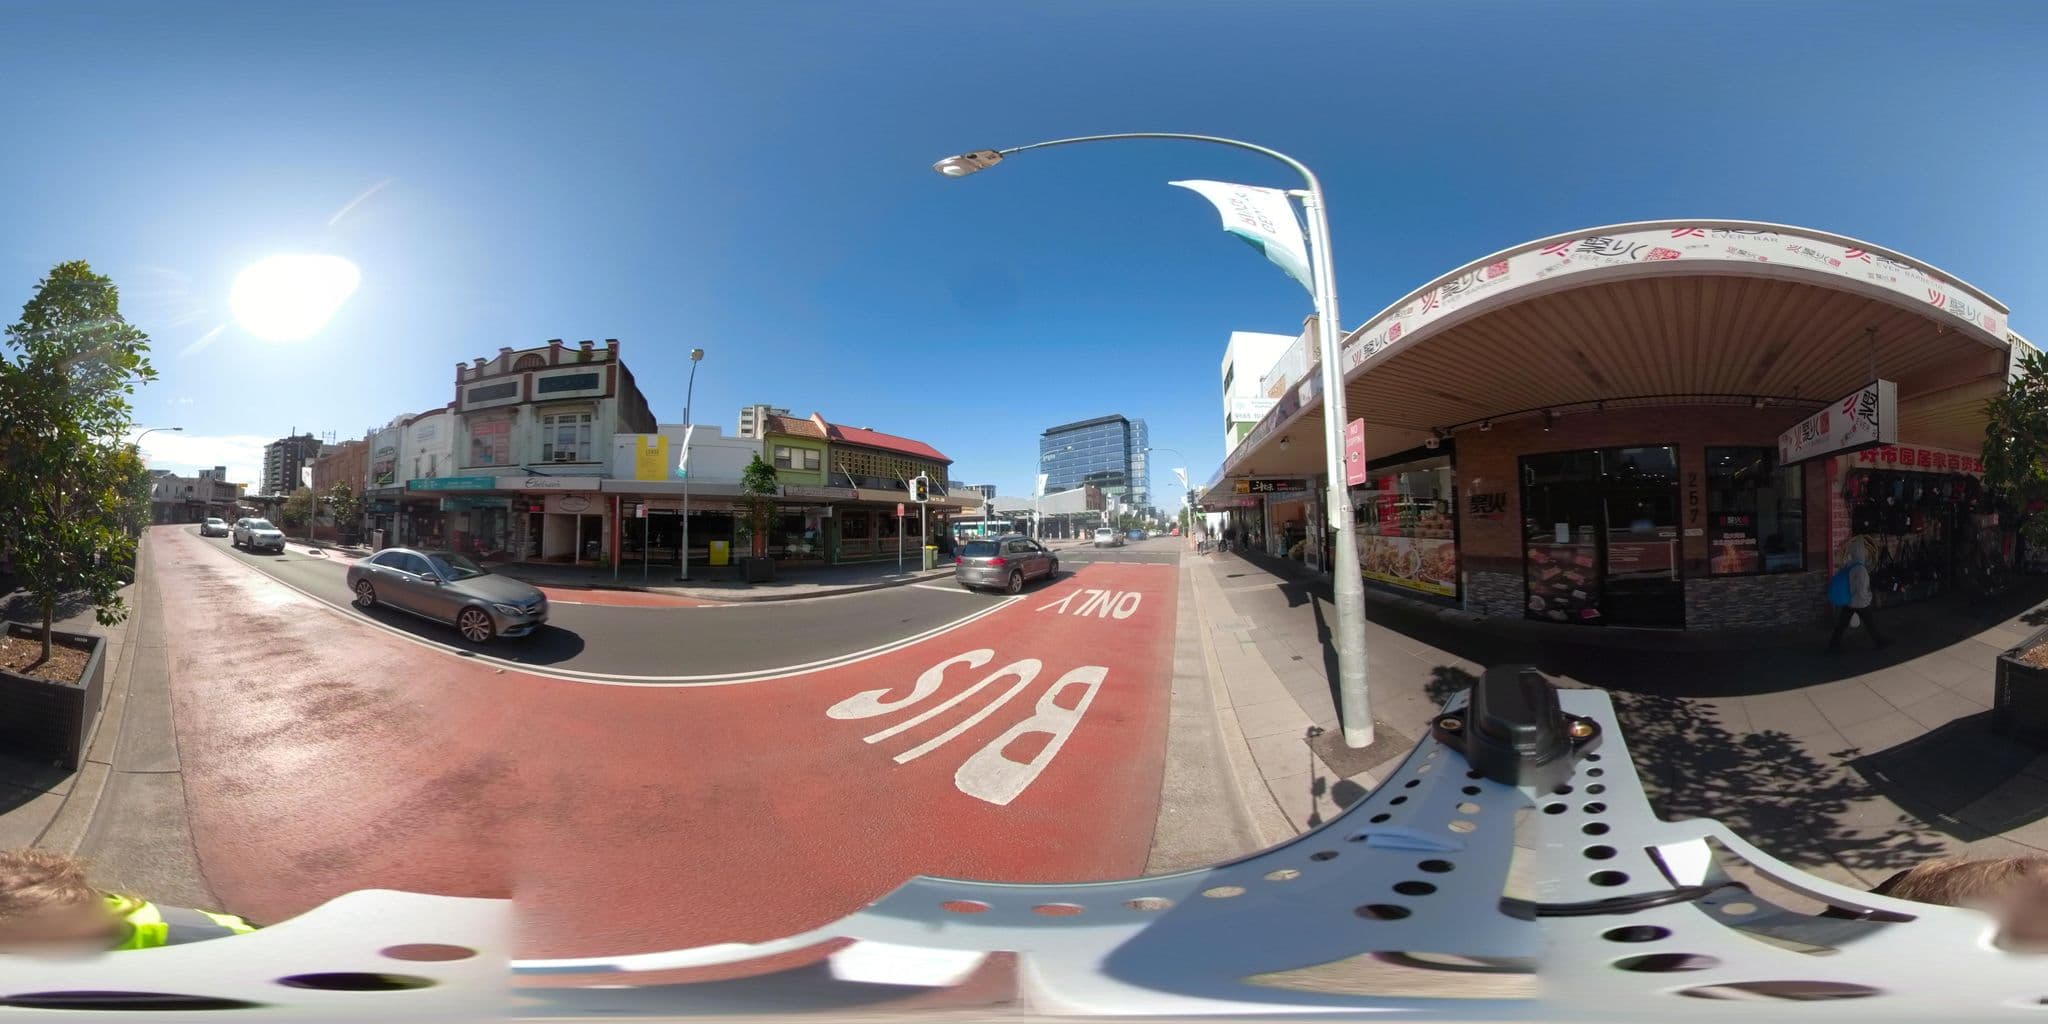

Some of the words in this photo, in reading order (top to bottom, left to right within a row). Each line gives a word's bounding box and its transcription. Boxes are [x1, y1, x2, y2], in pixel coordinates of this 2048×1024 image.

[1712, 233, 1745, 241] EVER
[1687, 472, 1699, 522] 257
[1036, 588, 1142, 619] ONLY
[826, 648, 1109, 806] BUS
